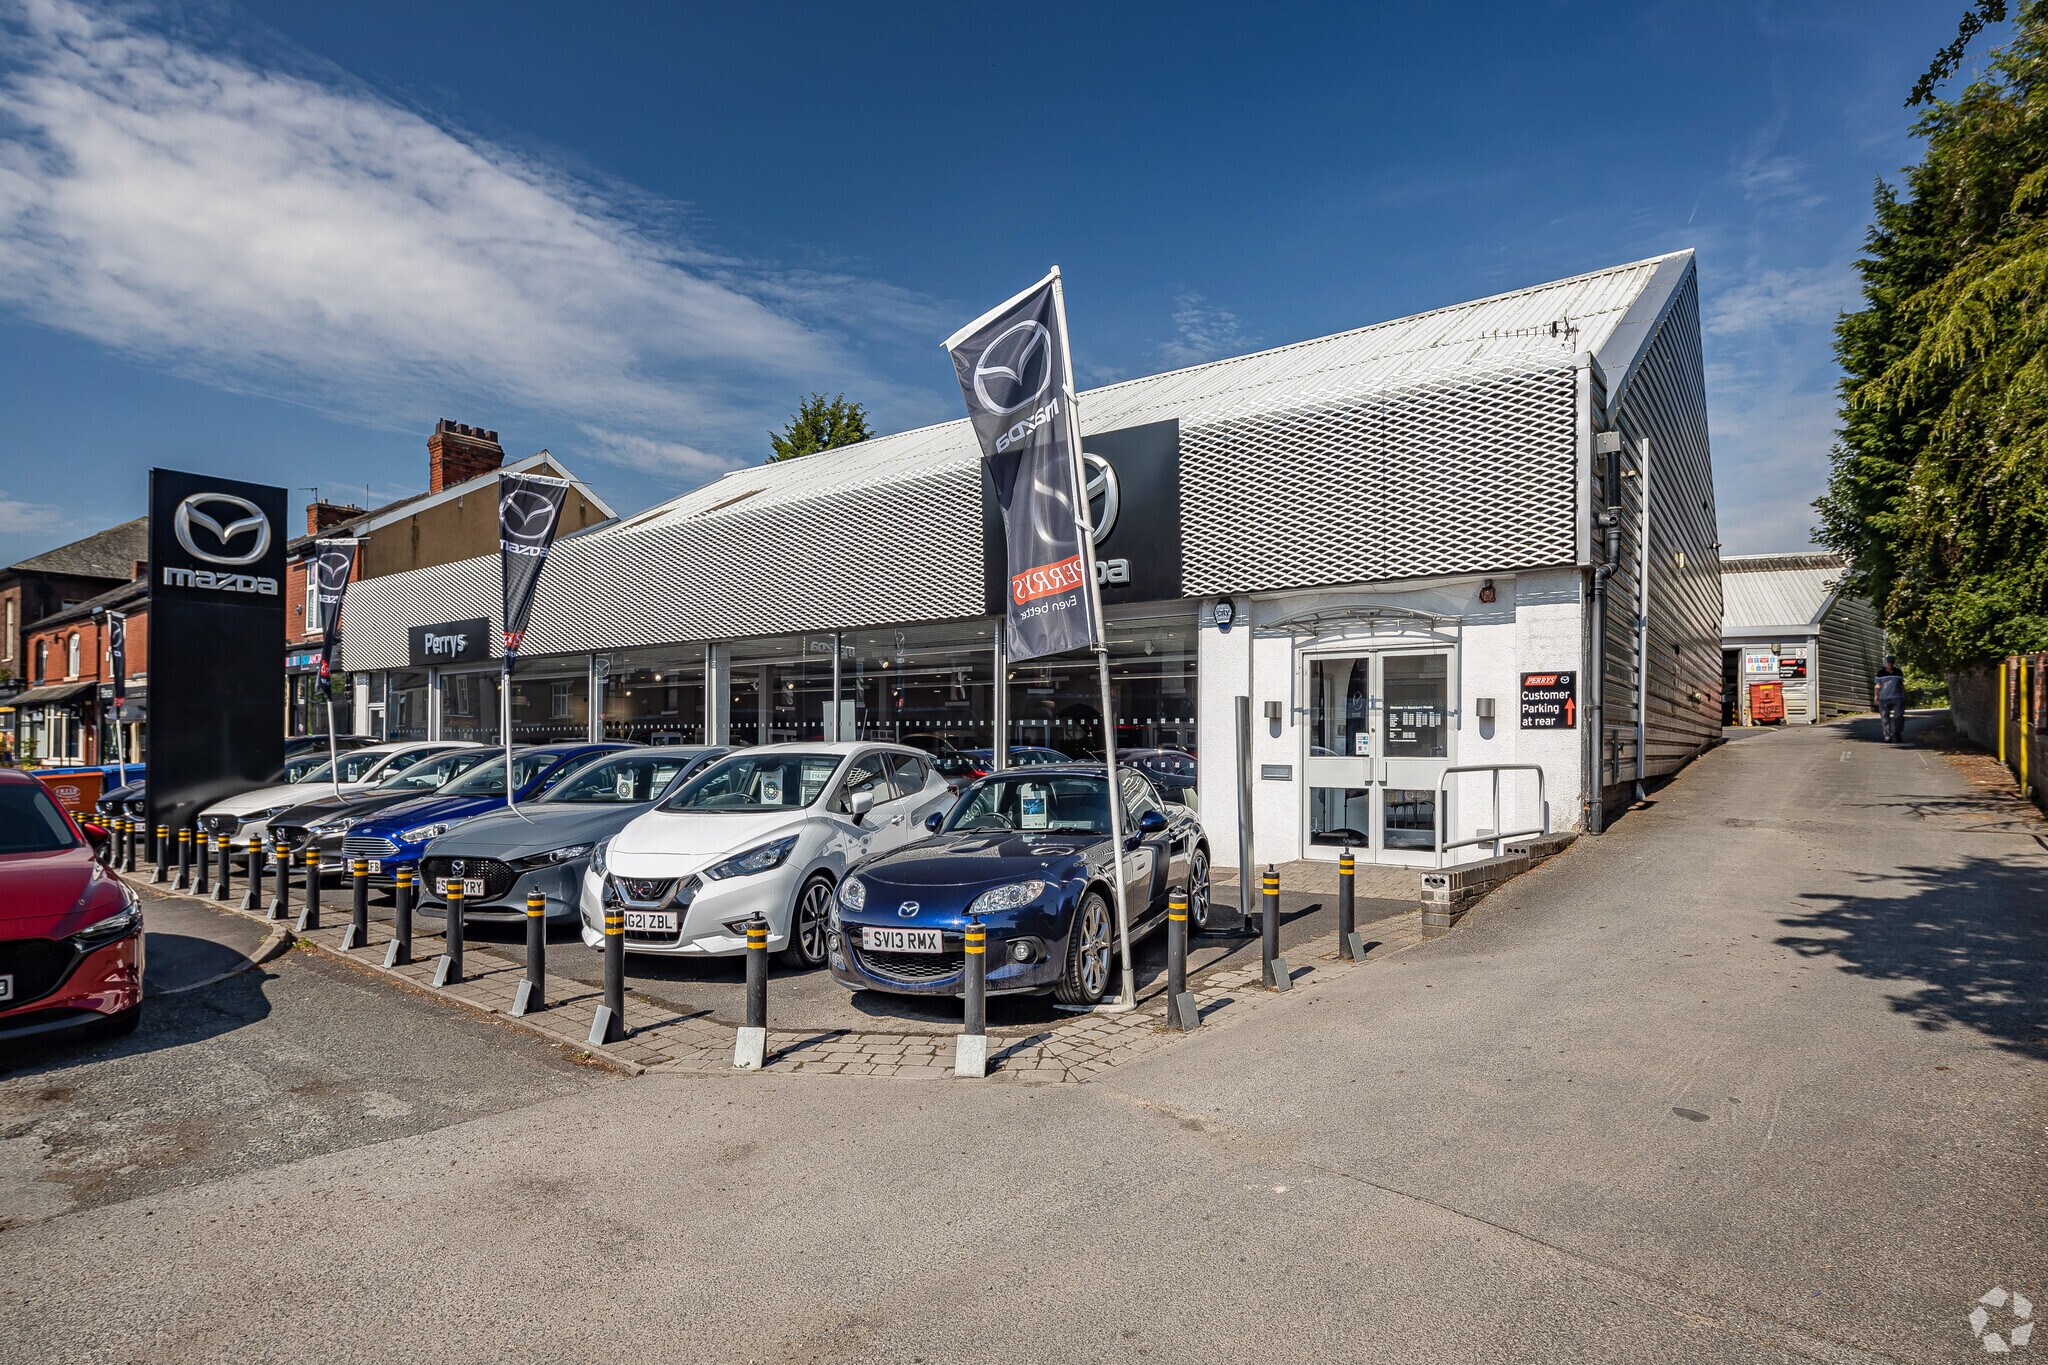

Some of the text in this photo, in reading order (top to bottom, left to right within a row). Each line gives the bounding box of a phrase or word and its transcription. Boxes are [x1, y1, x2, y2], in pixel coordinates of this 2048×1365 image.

[163, 566, 278, 595] mazda
[425, 633, 468, 658] Perrys
[1527, 676, 1555, 684] PERRYS
[1522, 690, 1570, 700] Customer
[1522, 703, 1559, 714] Parking
[1522, 717, 1555, 726] at rear
[649, 916, 672, 929] ZBL
[873, 931, 904, 950] SV13
[908, 932, 937, 950] RMX
